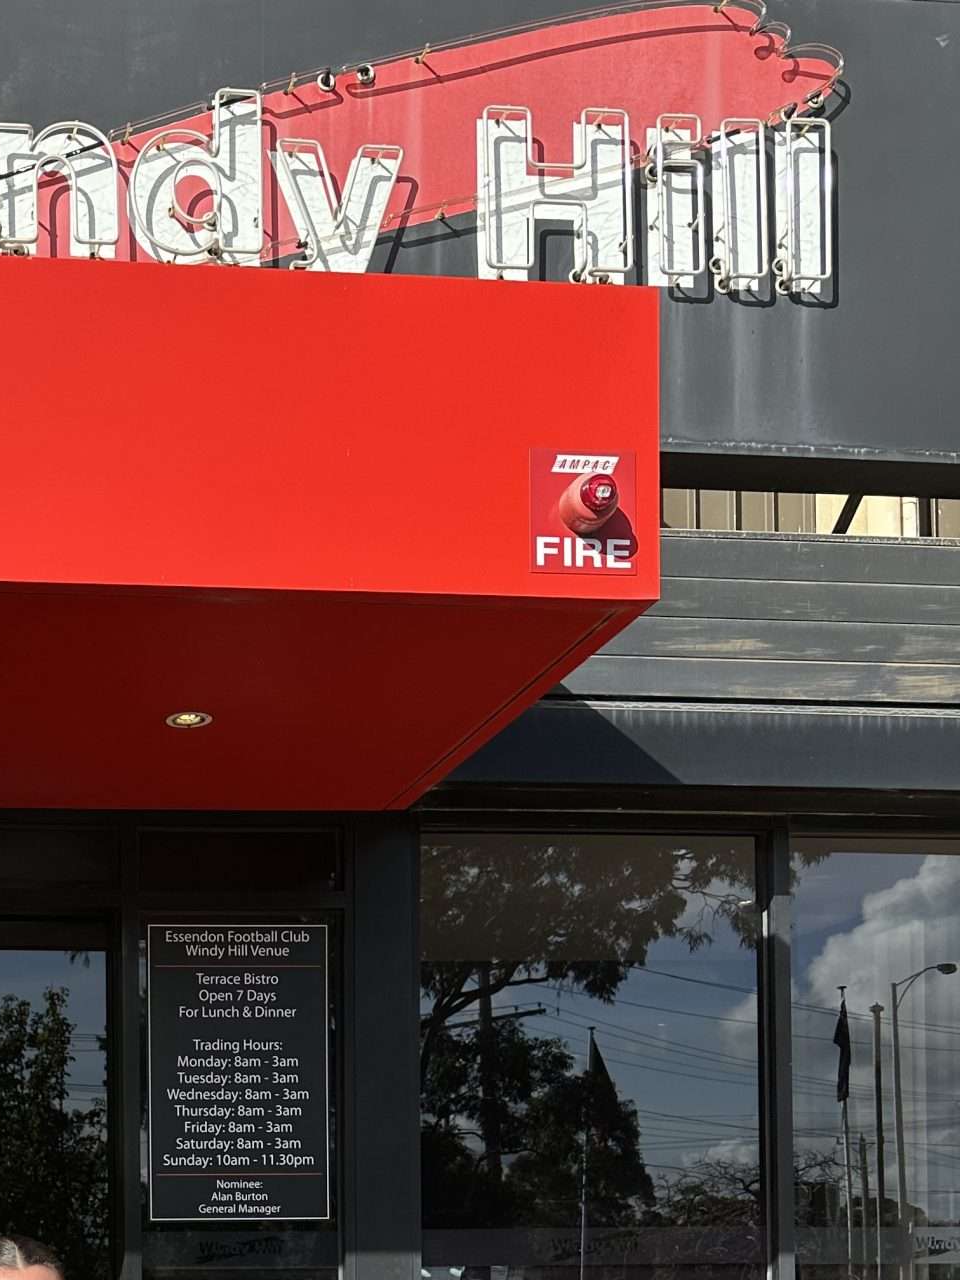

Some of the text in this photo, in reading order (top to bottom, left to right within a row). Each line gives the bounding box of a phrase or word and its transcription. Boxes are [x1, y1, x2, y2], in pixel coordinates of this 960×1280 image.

[476, 104, 836, 296] Hill
[536, 536, 632, 569] FIRE
[165, 931, 310, 943] Essendon Football Club
[186, 945, 290, 959] Windy Hill Venue
[196, 973, 278, 985] Terrace Bistro
[199, 990, 276, 1003] Open 7 Days
[179, 1006, 296, 1018] For Lunch & Dinner
[193, 1039, 282, 1053] Trading Hours:
[177, 1056, 298, 1069] Monday: 8am 3am
[177, 1072, 298, 1086] Tuesday: 8am 3am
[167, 1089, 309, 1102] Wednesday: 8am 3am
[174, 1105, 301, 1119] Thursday: 8am 3am
[184, 1122, 292, 1135] Friday: 8am 3am
[176, 1138, 301, 1152] Saturday: 8am 3am
[163, 1155, 314, 1168] Sunday: 10am 11.30pm
[216, 1180, 263, 1188] Nominee:
[211, 1192, 267, 1201] Alan Burton
[199, 1204, 280, 1216] General Manager
